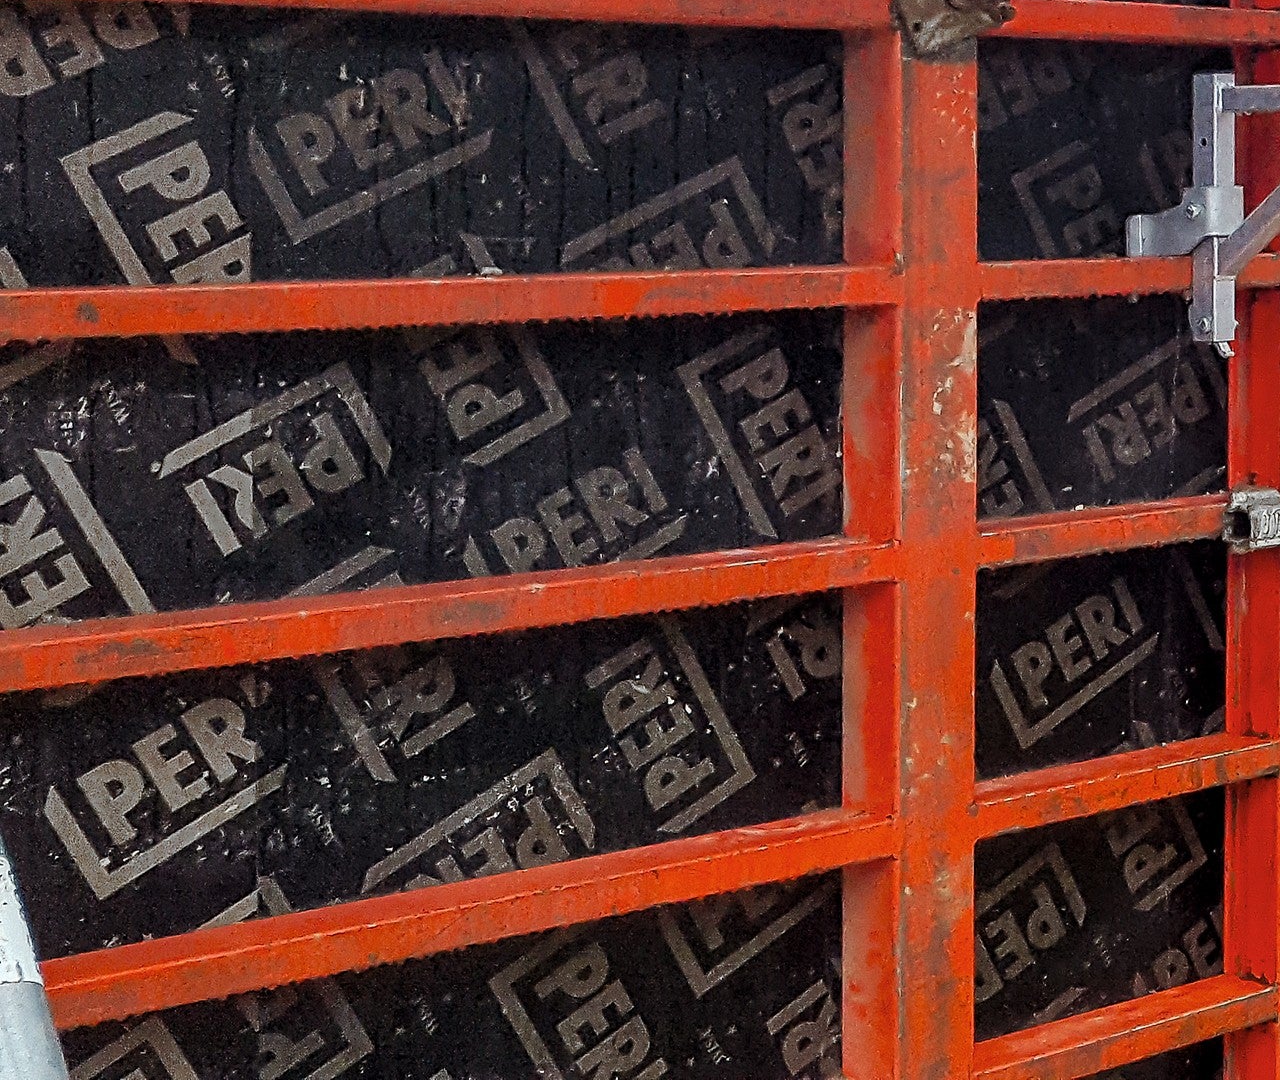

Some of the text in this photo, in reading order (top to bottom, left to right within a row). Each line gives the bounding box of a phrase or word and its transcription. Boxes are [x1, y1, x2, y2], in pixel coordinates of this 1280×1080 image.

[275, 47, 472, 196] PERI
[117, 139, 252, 283] PER
[185, 410, 366, 548] PERI
[719, 347, 842, 517] PERI
[1082, 360, 1210, 483] PERI
[489, 446, 669, 574] PERI
[1010, 575, 1144, 710] PERI
[583, 636, 716, 813] PERI
[975, 881, 1066, 1004] PER
